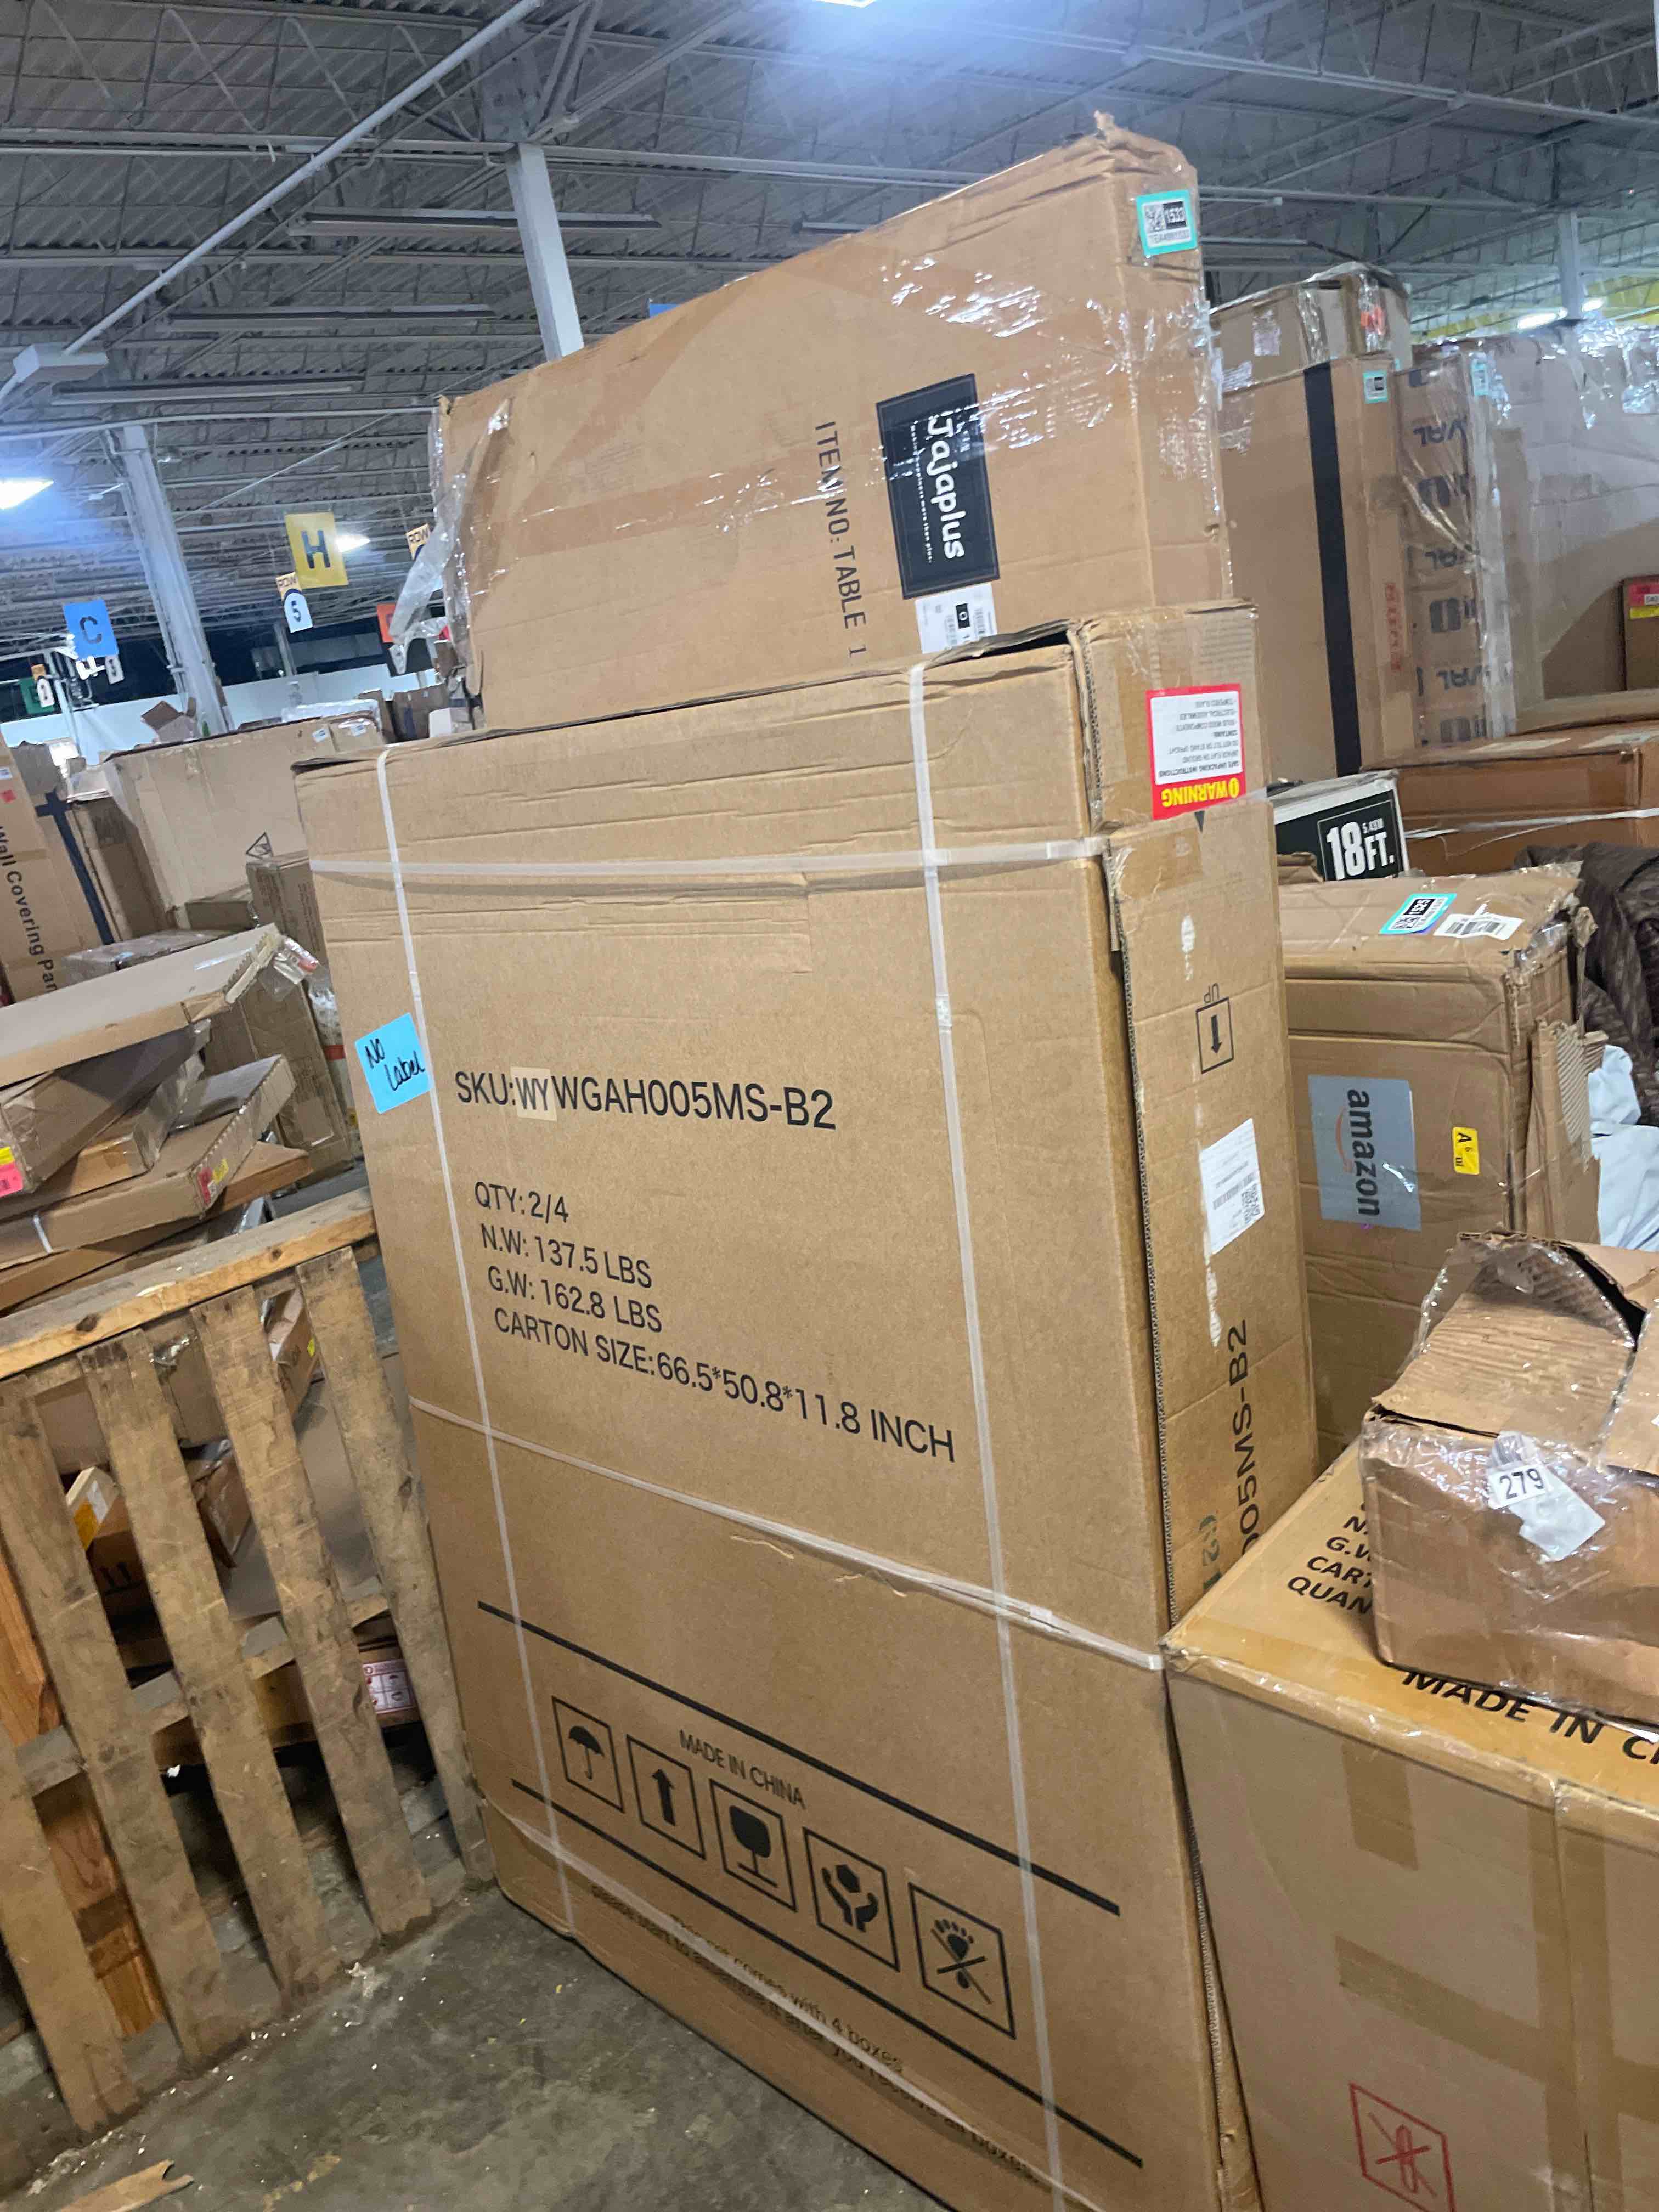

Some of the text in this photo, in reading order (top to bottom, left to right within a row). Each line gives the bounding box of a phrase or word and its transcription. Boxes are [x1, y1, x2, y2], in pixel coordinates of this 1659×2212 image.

[926, 415, 966, 559] Jajaplus
[407, 527, 430, 544] ROW
[826, 497, 850, 543] NO:
[301, 529, 331, 569] H
[833, 545, 867, 629] TABLE
[79, 616, 103, 644] C
[1161, 780, 1229, 808] WARNING
[1326, 821, 1395, 880] 18 FT.
[7, 870, 44, 956] Covering
[1204, 982, 1220, 1005] UP
[1347, 1088, 1380, 1217] amazon
[1457, 1132, 1472, 1143] A
[603, 1251, 652, 1289] LBS
[613, 1295, 662, 1333] LBS
[494, 1307, 589, 1357] CARTON
[871, 1409, 956, 1463] INCH
[1499, 1468, 1544, 1500] 279
[1402, 1671, 1531, 1723] MADE
[1549, 1711, 1606, 1745] IN
[680, 1729, 807, 1810] MADE IN CHINA
